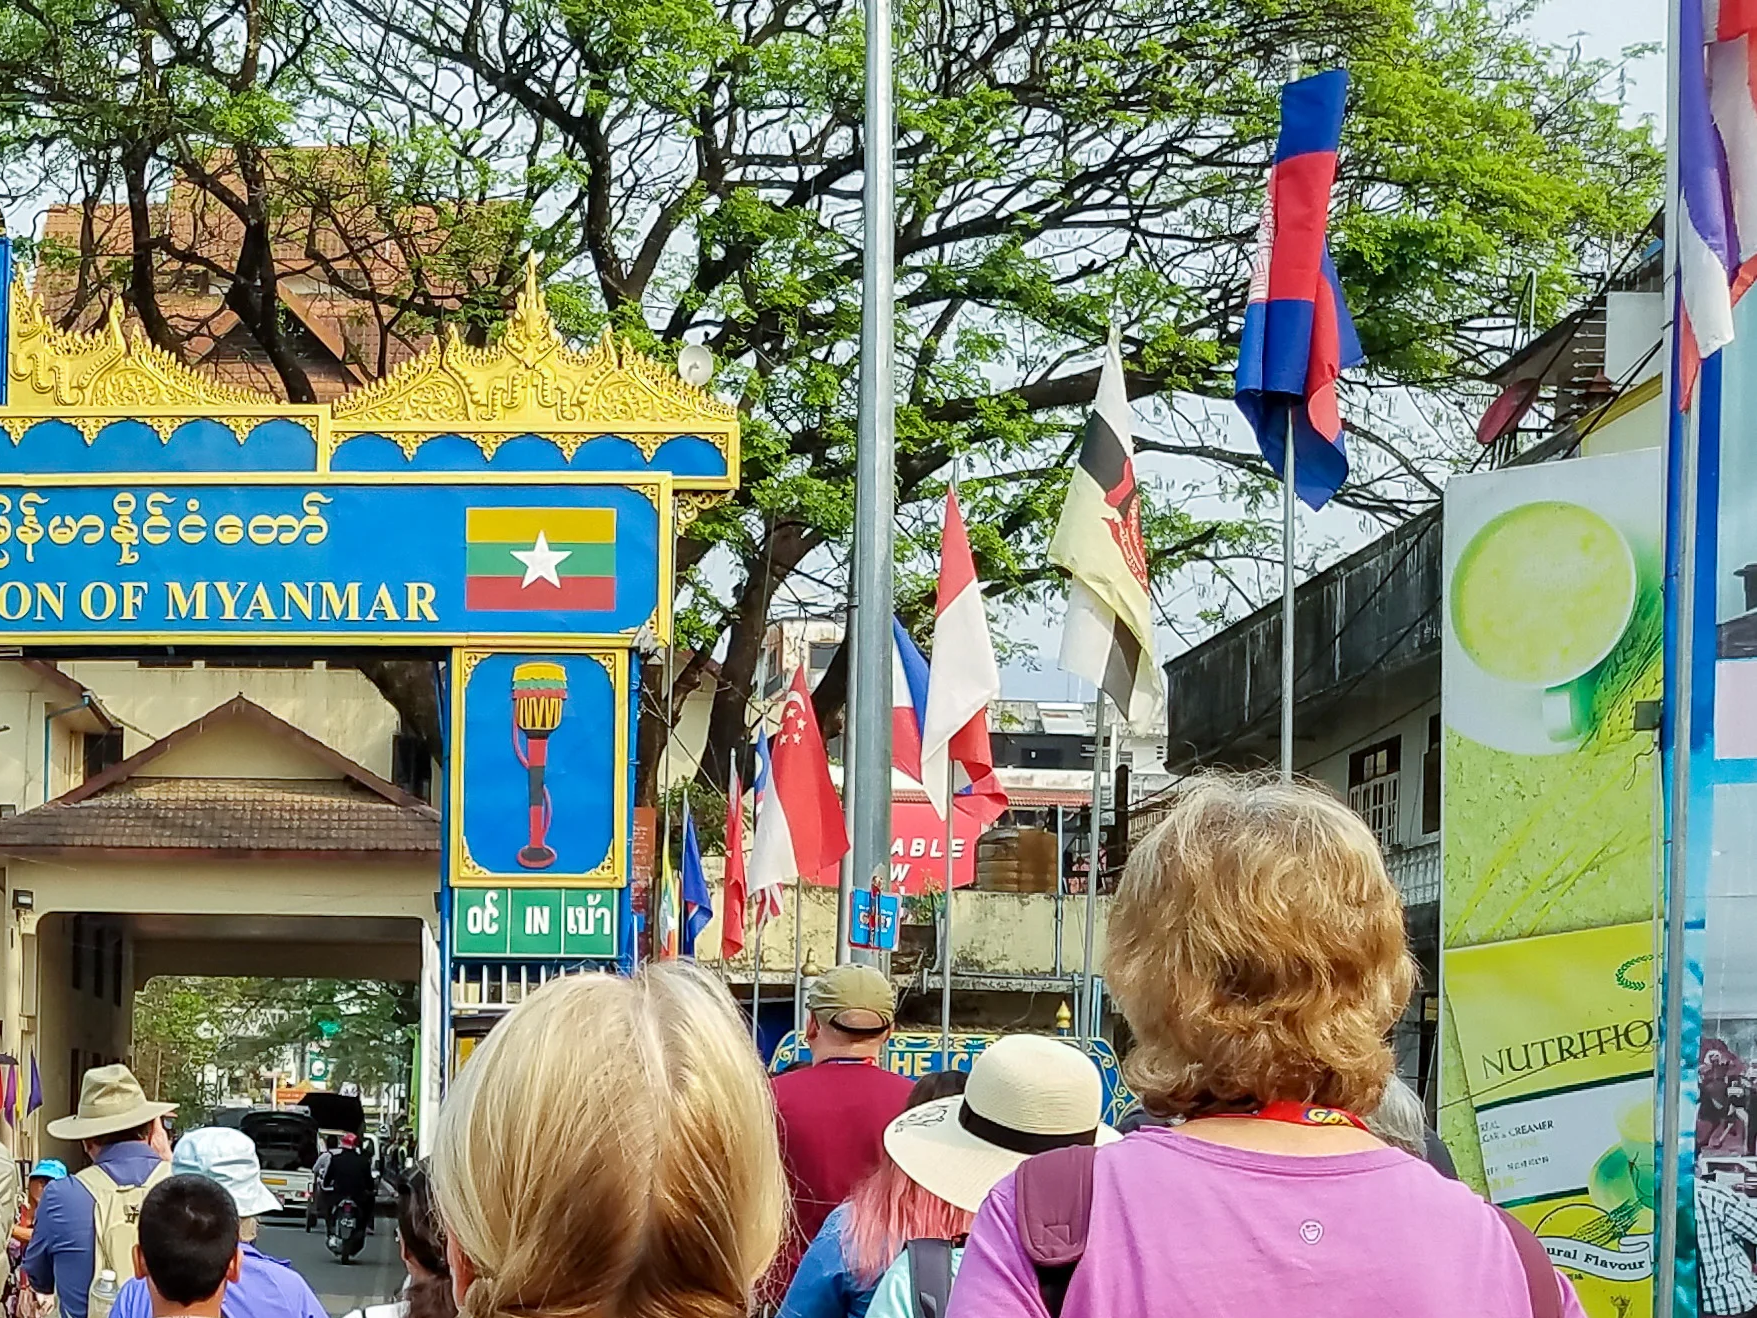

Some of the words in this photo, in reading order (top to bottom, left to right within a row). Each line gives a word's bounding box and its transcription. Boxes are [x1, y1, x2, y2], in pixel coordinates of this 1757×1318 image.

[80, 582, 149, 621] OF
[165, 582, 440, 622] MYANMAR
[524, 906, 551, 935] IN
[566, 893, 612, 935] เข้า
[890, 1052, 932, 1077] HE
[1481, 1020, 1654, 1080] NUTRITIO
[1508, 1120, 1554, 1137] CREAMER
[1546, 1247, 1578, 1260] ural
[1583, 1253, 1645, 1271] Flavour
